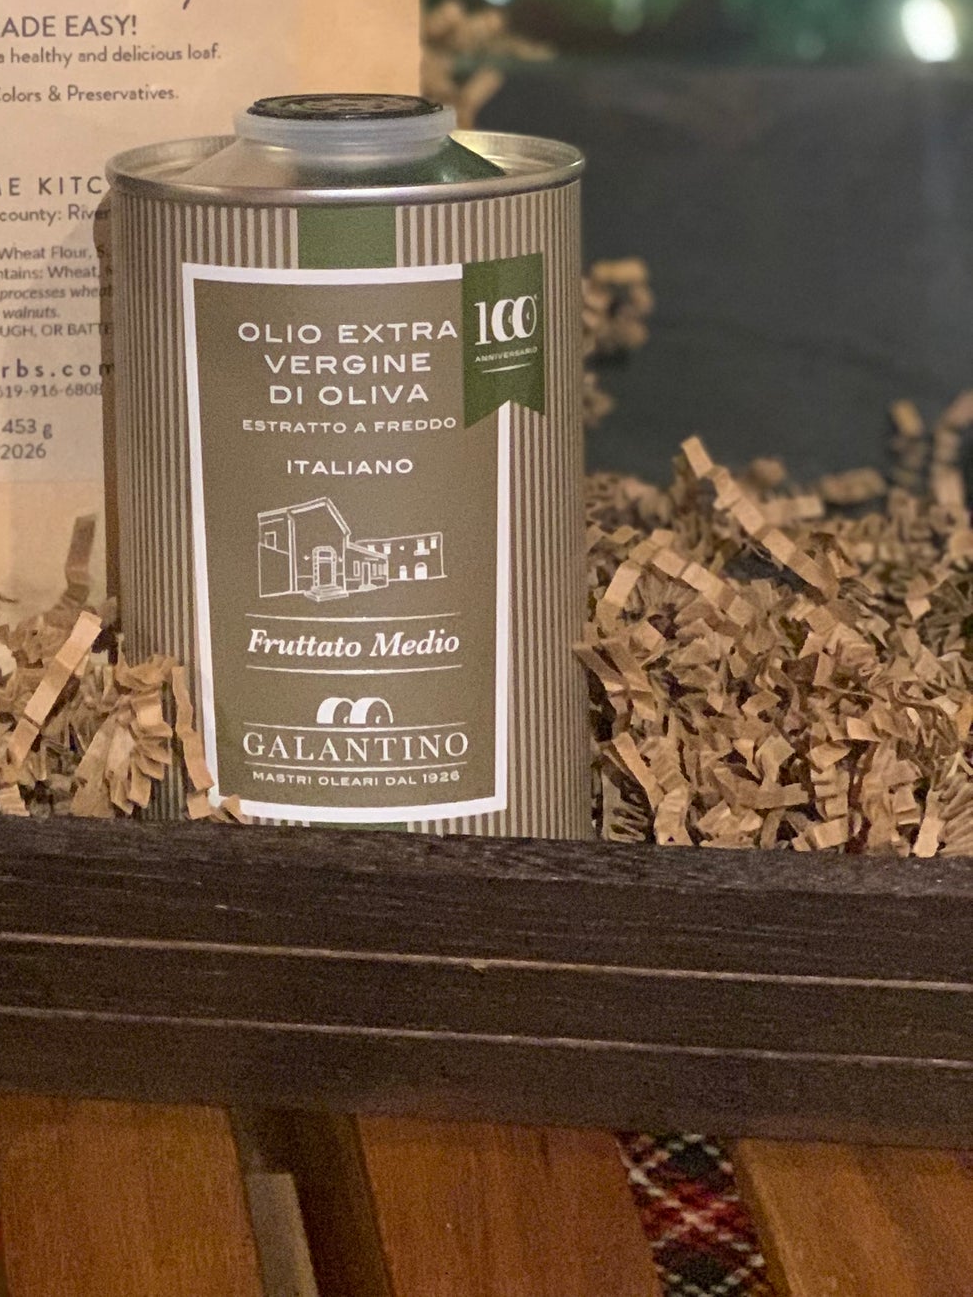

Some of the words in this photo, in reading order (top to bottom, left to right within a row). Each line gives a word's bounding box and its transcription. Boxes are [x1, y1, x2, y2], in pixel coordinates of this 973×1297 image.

[66, 14, 138, 37] EASY!
[10, 45, 73, 69] healthy
[78, 45, 107, 63] and
[112, 44, 182, 62] delicious
[187, 42, 222, 61] loaf.
[48, 85, 62, 102] &
[67, 83, 180, 102] Preservatives.
[0, 207, 62, 227] county:
[0, 288, 66, 304] processes
[41, 323, 64, 337] OR
[238, 322, 322, 344] OLIO
[338, 320, 458, 344] EXTRA
[264, 352, 432, 375] VERGINE
[269, 385, 303, 406] DI
[318, 383, 429, 406] OLIVA
[2, 418, 37, 435] 453
[42, 422, 54, 440] g
[242, 419, 347, 434] ESTRATTO
[354, 421, 367, 434] A
[374, 417, 457, 433] FREDDO
[287, 458, 414, 476] ITALIANO
[247, 628, 362, 658] Fruttato
[369, 628, 460, 658] Medio
[243, 731, 469, 763] GALANTINO
[252, 770, 312, 785] MASTRI
[318, 775, 379, 787] OLEARI
[385, 774, 417, 786] DAL
[422, 770, 460, 784] 1926
